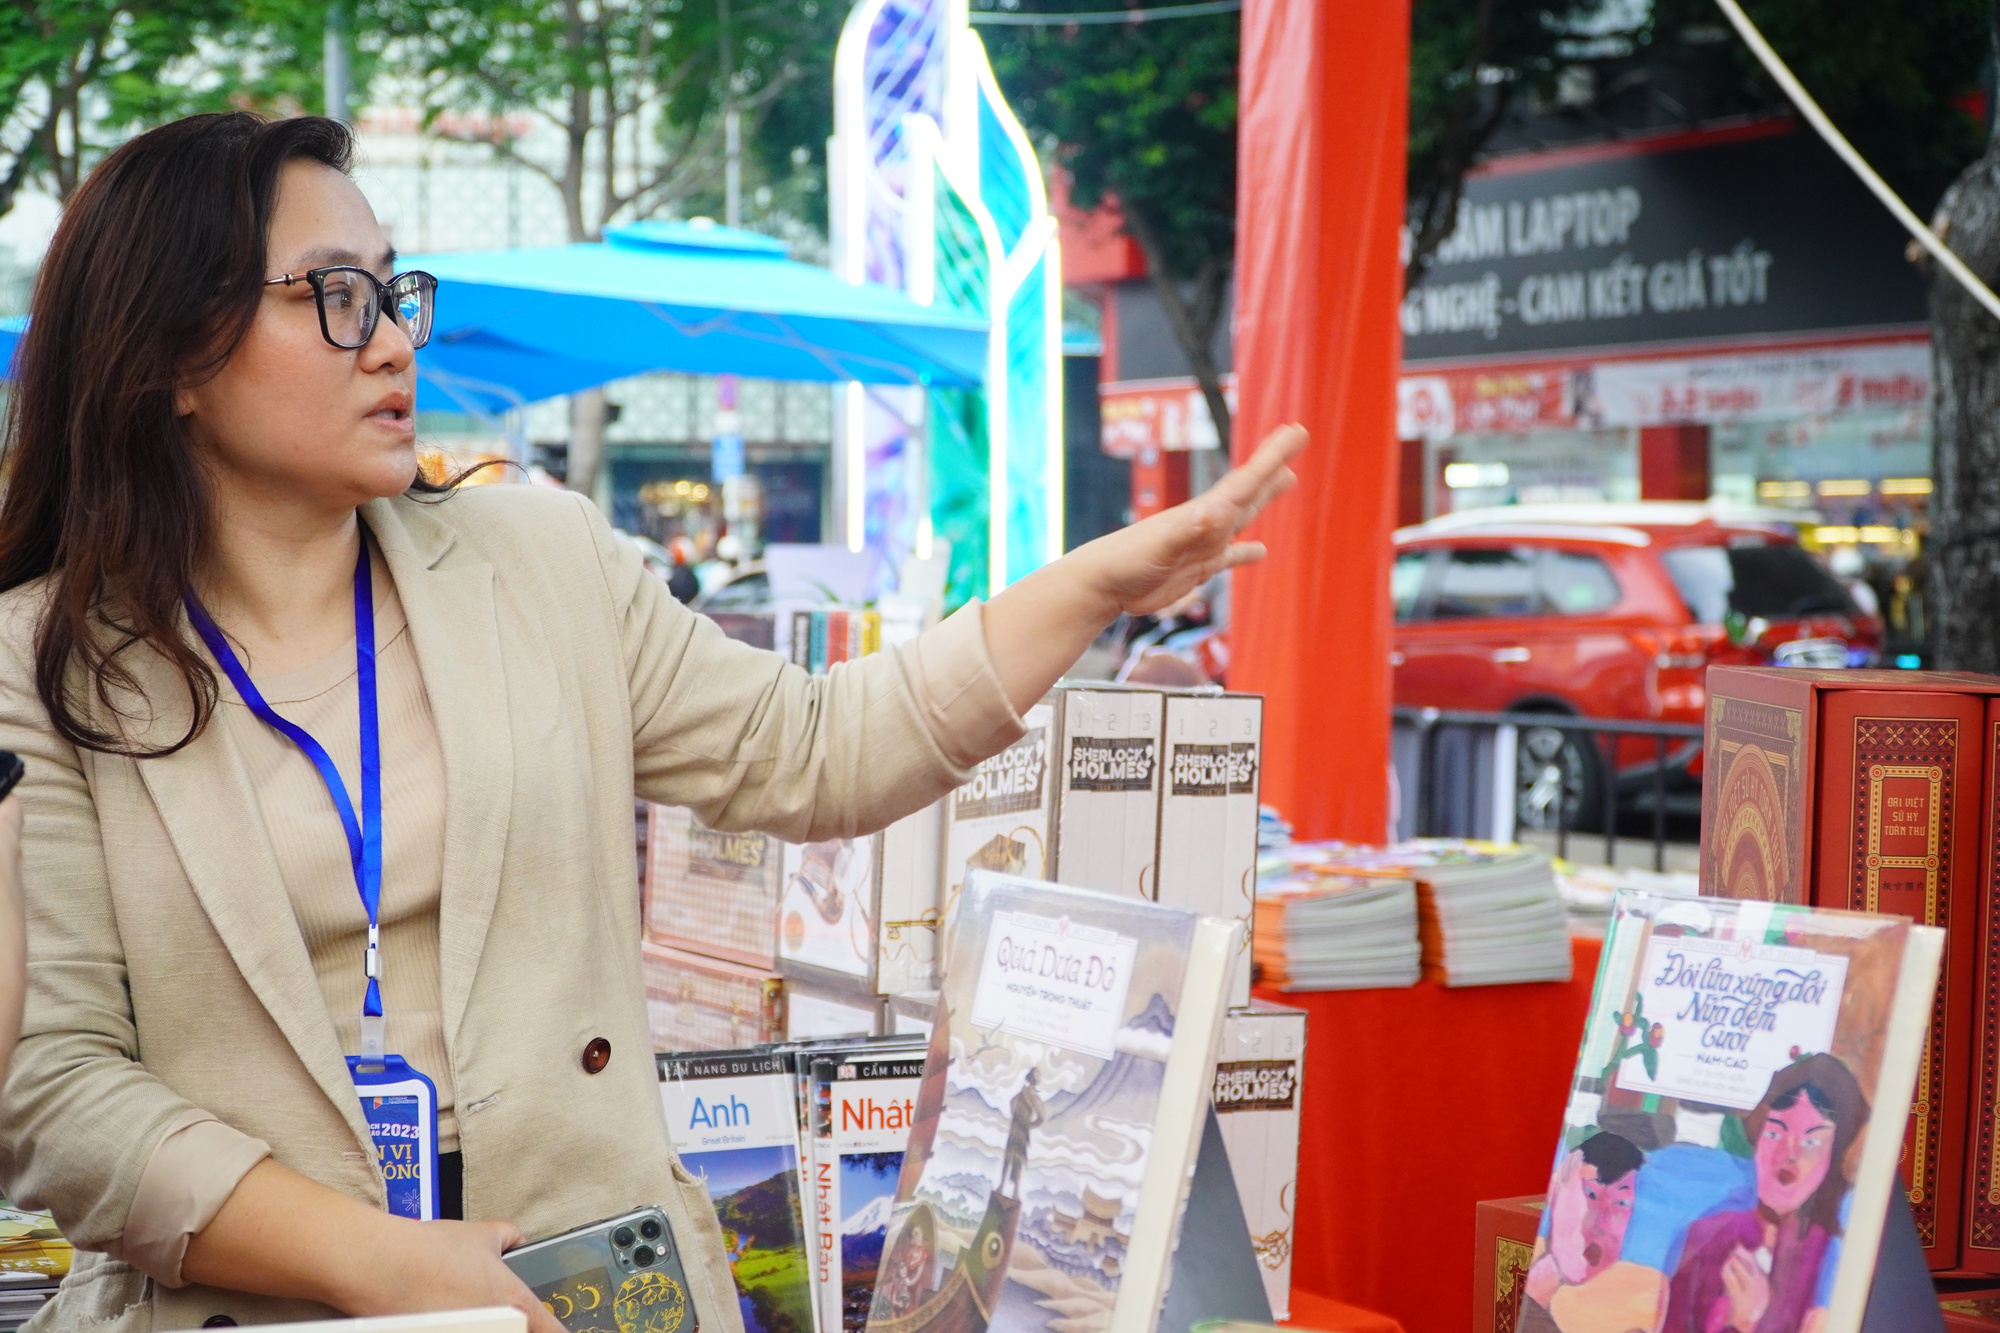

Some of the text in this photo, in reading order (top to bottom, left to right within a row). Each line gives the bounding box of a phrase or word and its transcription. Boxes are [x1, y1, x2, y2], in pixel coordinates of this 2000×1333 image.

[1506, 186, 1642, 257] LAPTOP
[1423, 272, 1501, 341] NGHỆ
[1518, 271, 1587, 325] CAM
[1588, 254, 1647, 319] KẾT
[1650, 249, 1706, 314] GIÁ
[1708, 238, 1773, 308] TỐT
[977, 745, 1036, 775] ERLOCK
[1073, 747, 1145, 763] SHERLOCK
[1175, 752, 1246, 769] SHERLOCK
[1072, 761, 1150, 780] HOLMES
[1174, 766, 1251, 785] HOLMES
[958, 765, 1038, 803] HOLMES
[1887, 796, 1925, 809] ĐẠI VIỆT
[1892, 810, 1905, 822] SỬ
[1884, 825, 1926, 837] TOÀN THƯ
[997, 936, 1116, 992] Quả Dưa Đỏ
[694, 1064, 727, 1076] NANG
[732, 1063, 748, 1074] DU
[752, 1060, 781, 1074] LỊCH
[838, 1062, 924, 1079] DK CẨM NANG
[1217, 1070, 1286, 1086] SHERLOCK
[1216, 1080, 1290, 1103] HOLMES
[689, 1094, 750, 1130] Anh
[842, 1096, 914, 1135] Nhật
[382, 1123, 419, 1139] 2023
[701, 1136, 720, 1146] Great
[721, 1135, 746, 1145] Britain
[390, 1144, 412, 1164] VỊ
[816, 1163, 832, 1226] Nhật
[818, 1232, 833, 1284] Bản
